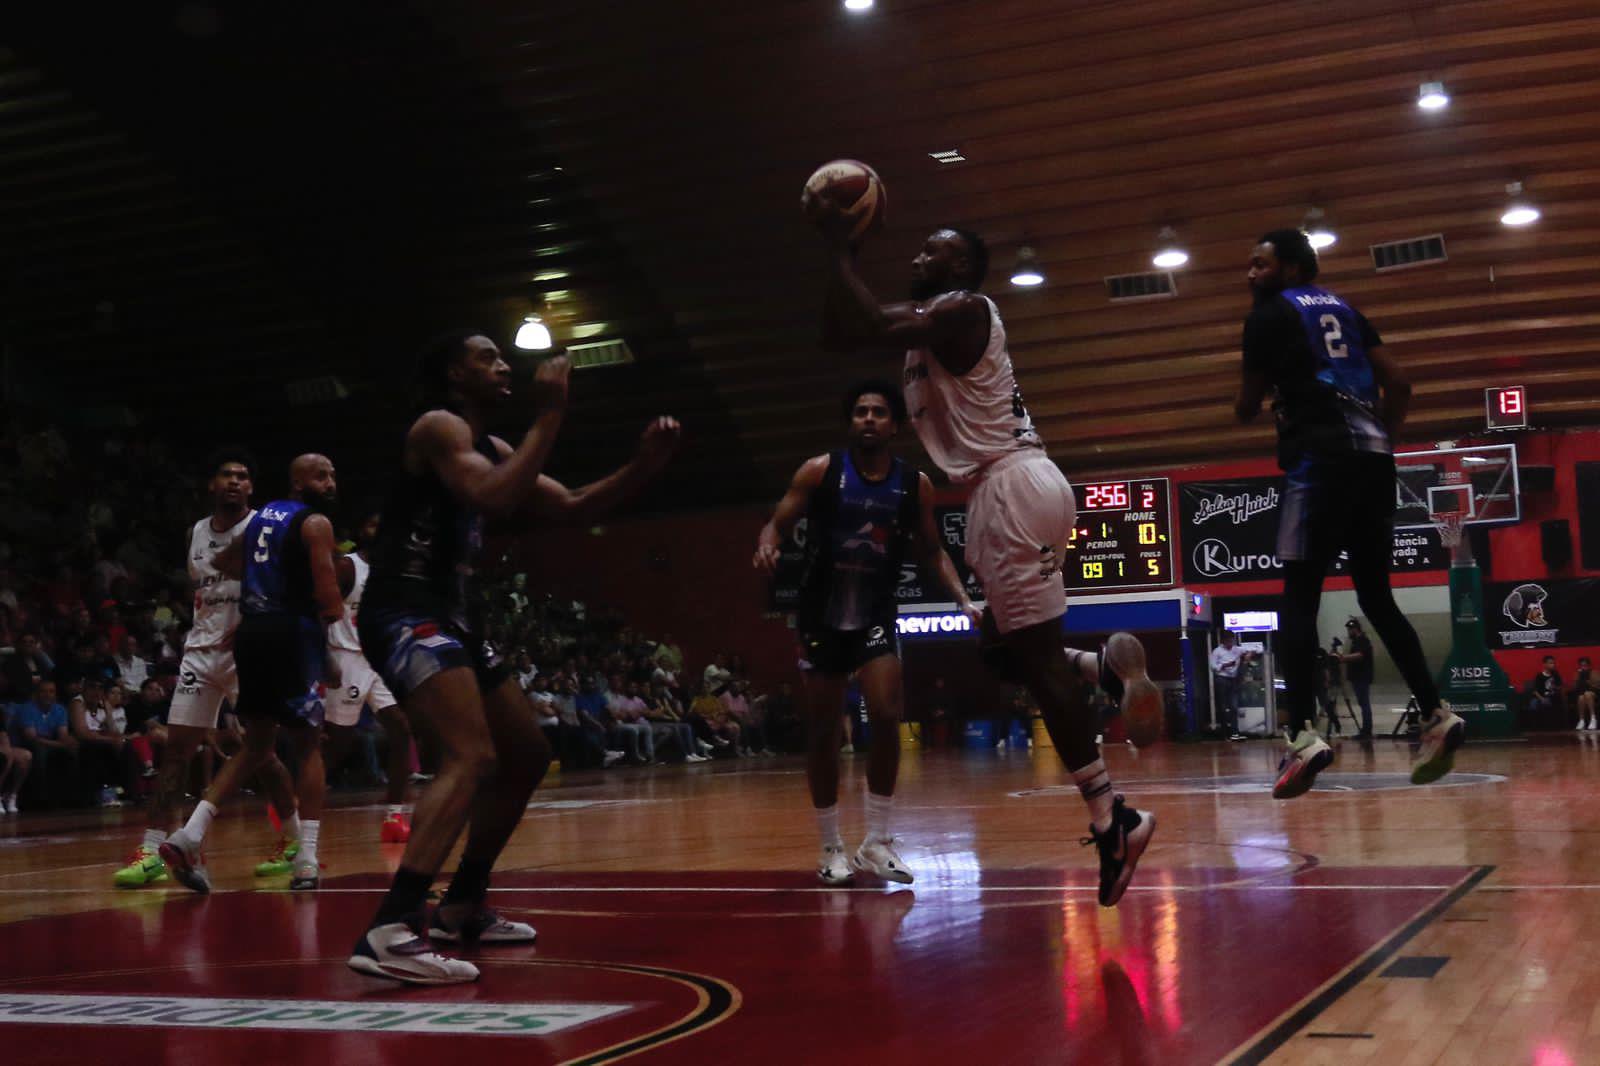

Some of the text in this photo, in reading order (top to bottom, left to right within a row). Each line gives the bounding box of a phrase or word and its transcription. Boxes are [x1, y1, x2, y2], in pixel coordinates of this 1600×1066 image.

[1319, 313, 1349, 358] 2
[1500, 391, 1520, 413] 13
[1085, 484, 1127, 508] 2:56
[1143, 491, 1153, 508] 2
[1124, 511, 1157, 521] HOME
[1138, 523, 1156, 544] 10
[254, 526, 274, 563] 5
[1086, 540, 1118, 549] PERIOD
[1082, 562, 1103, 579] 09
[1147, 559, 1159, 576] 5
